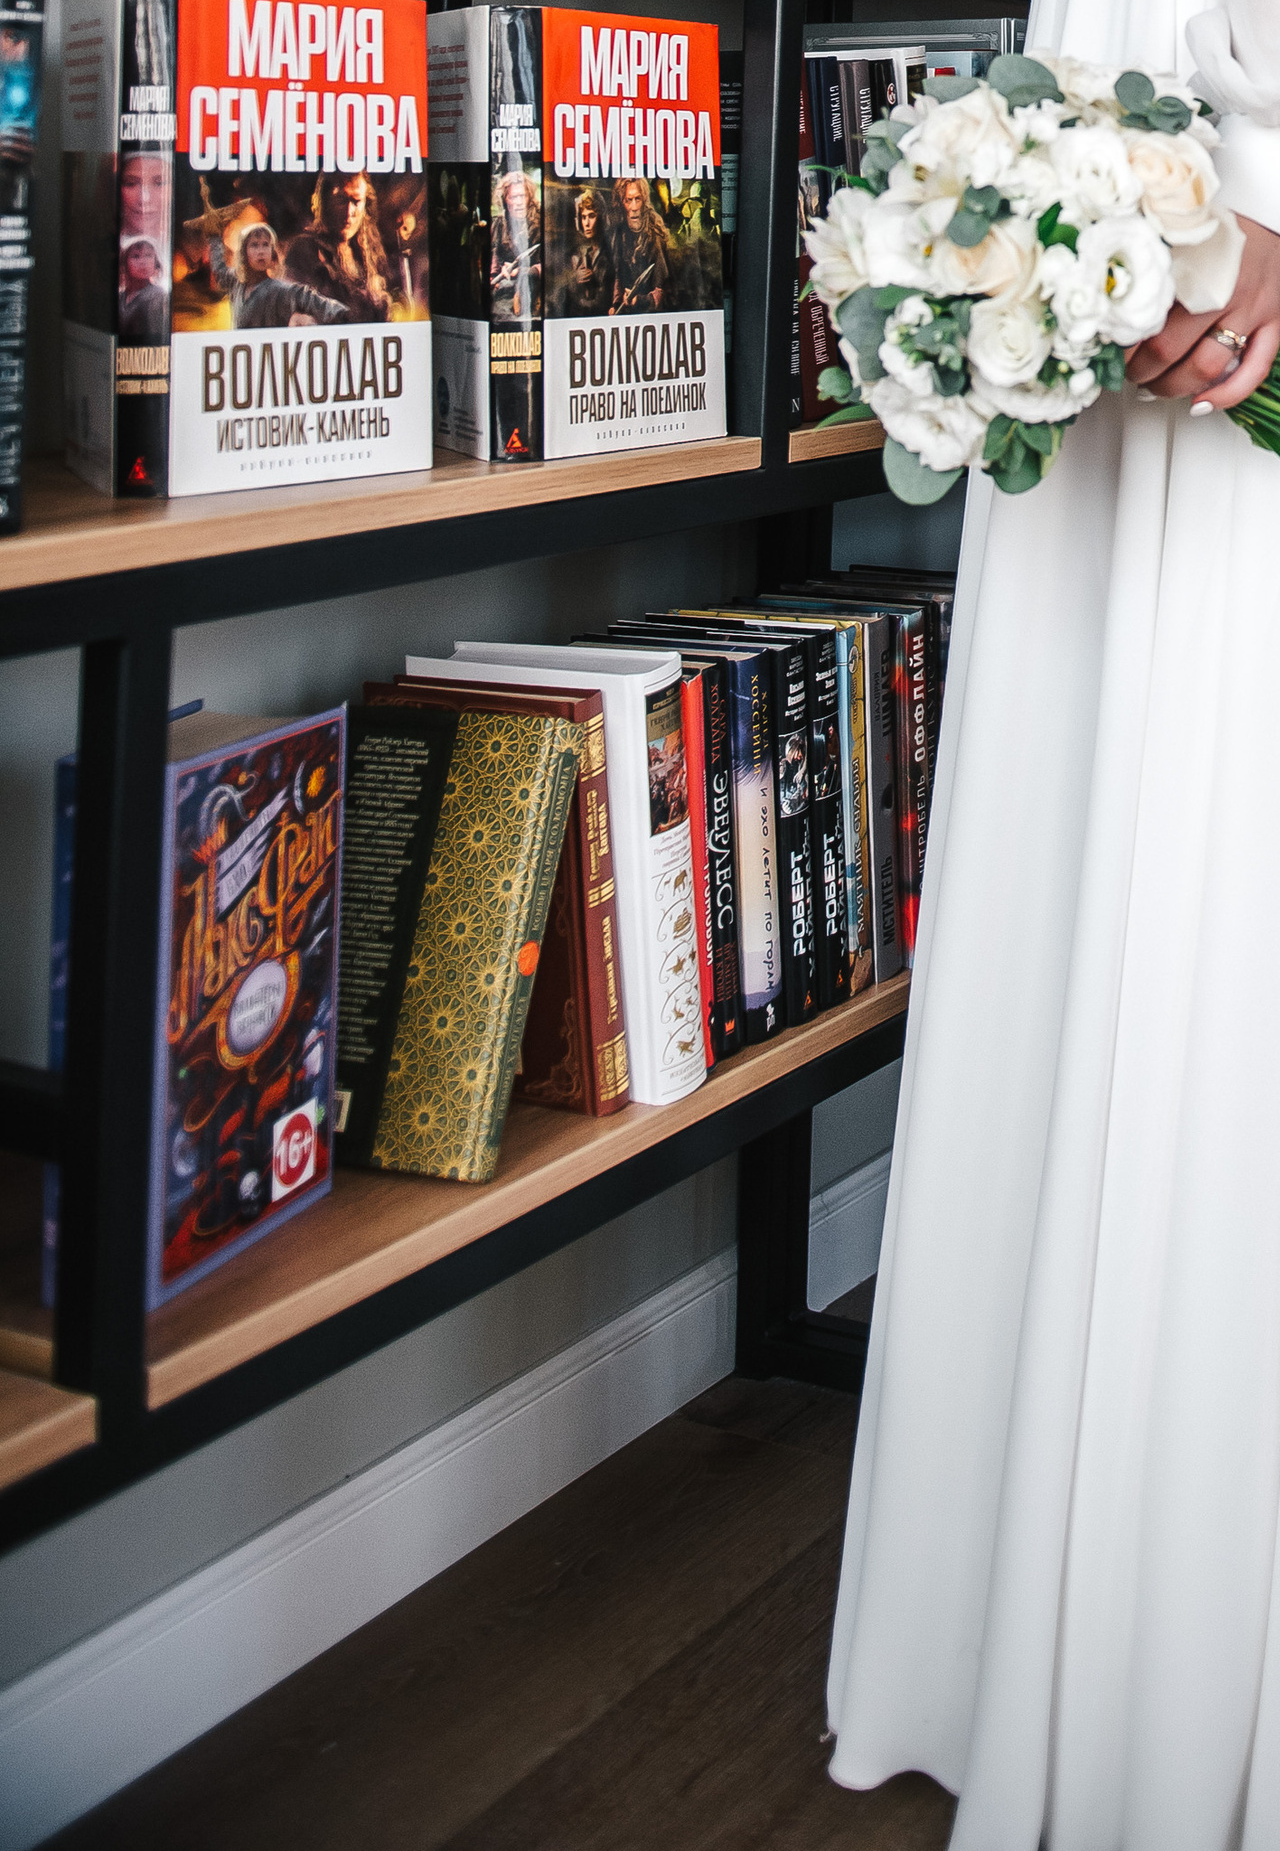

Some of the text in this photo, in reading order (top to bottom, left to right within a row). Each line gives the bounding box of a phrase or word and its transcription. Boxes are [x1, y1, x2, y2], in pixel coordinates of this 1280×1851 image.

[129, 86, 170, 113] МАРИЯ
[580, 26, 689, 102] МАРИЯ
[189, 81, 424, 175] СЕМЁНОВА
[499, 103, 535, 128] МАРИЯ
[555, 100, 716, 181] СЕМЁНОВА
[116, 348, 170, 377] ВОЛКОДАВ
[203, 336, 403, 414] ВОЛКОДАВ
[490, 331, 542, 358] ВОЛКОДАВ
[568, 322, 707, 390] ВОЛКОДАВ
[216, 406, 391, 454] ИСТОВИК-КАМЕНЬ
[569, 387, 707, 426] ПРАВО НА ПОЕДИНОК
[751, 673, 764, 775] ХОССЕЙНИ
[908, 633, 926, 763] ОФФЛАЙН
[707, 768, 735, 930] ЭВЕРЛЕСС
[823, 833, 839, 938] РОБЕРТ
[852, 840, 866, 934] МАЯТНИК
[790, 851, 806, 957] РОБЕРТ
[879, 855, 896, 946] МСТИТЕЛЬ
[275, 1125, 313, 1166] 16+
